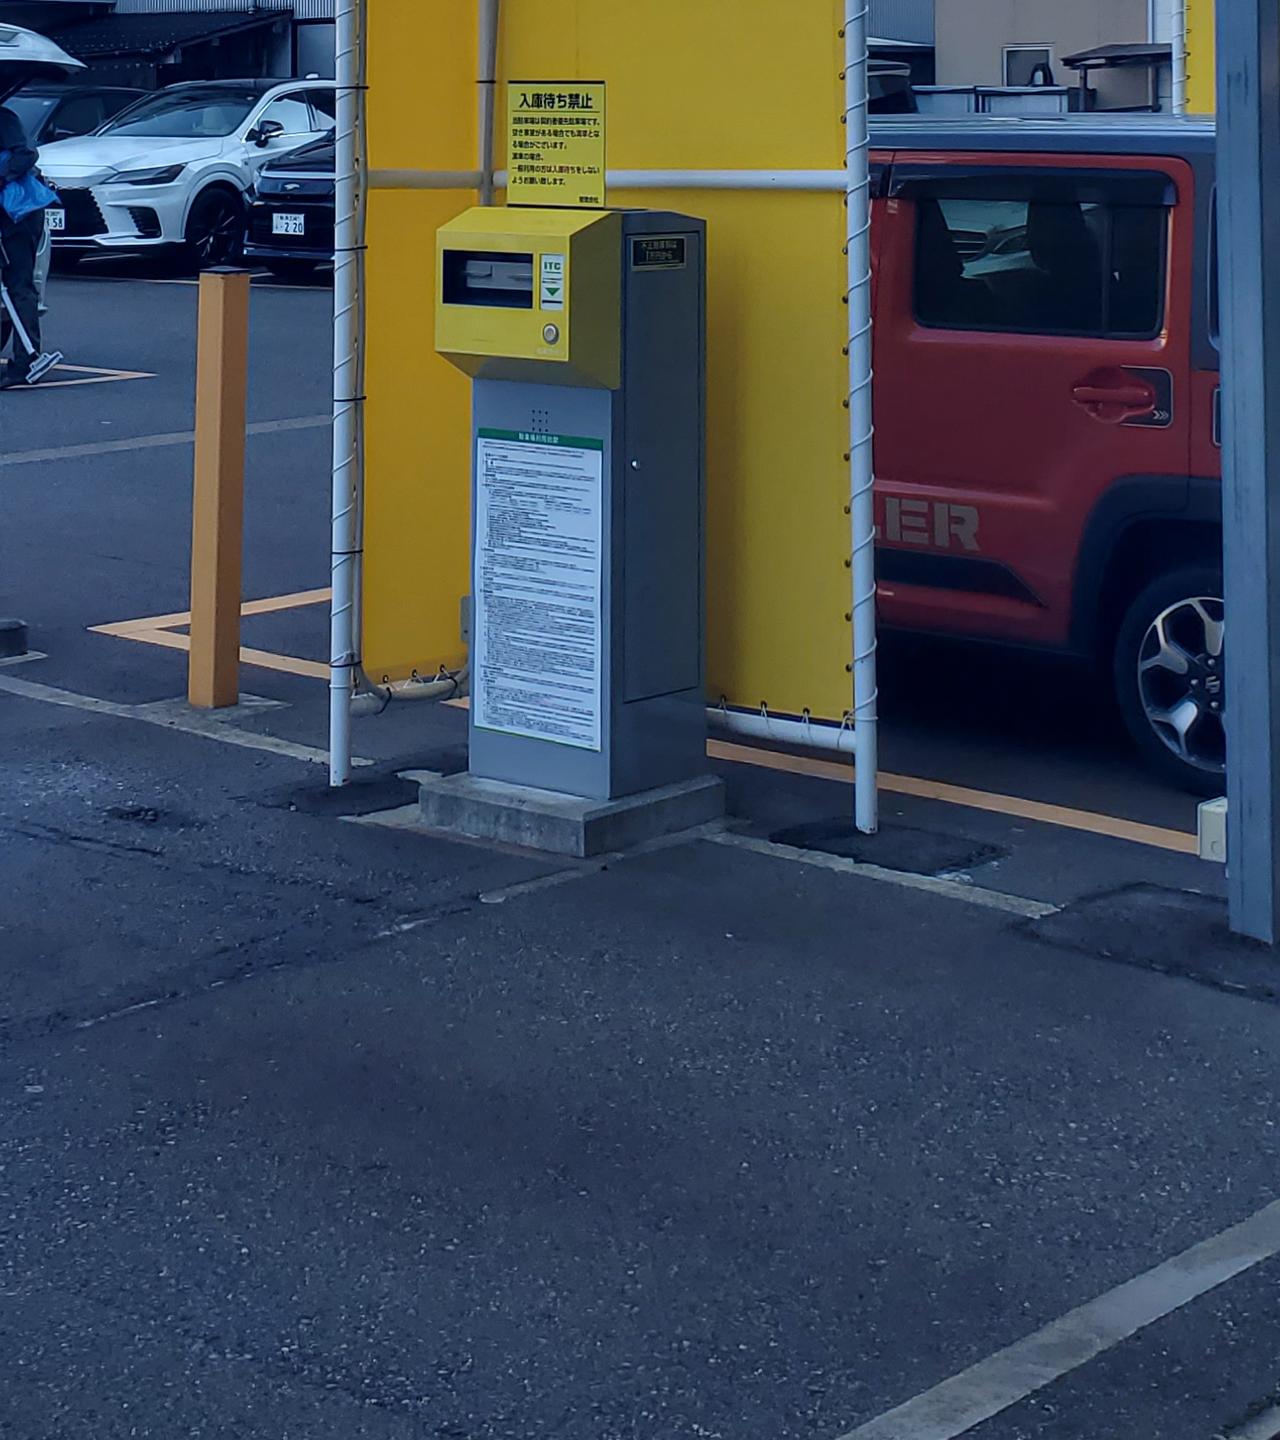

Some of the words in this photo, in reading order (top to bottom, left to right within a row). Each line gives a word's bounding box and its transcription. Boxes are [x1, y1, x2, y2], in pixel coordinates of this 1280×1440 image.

[519, 93, 594, 110] 入庫待ち禁止
[874, 496, 981, 552] ER
